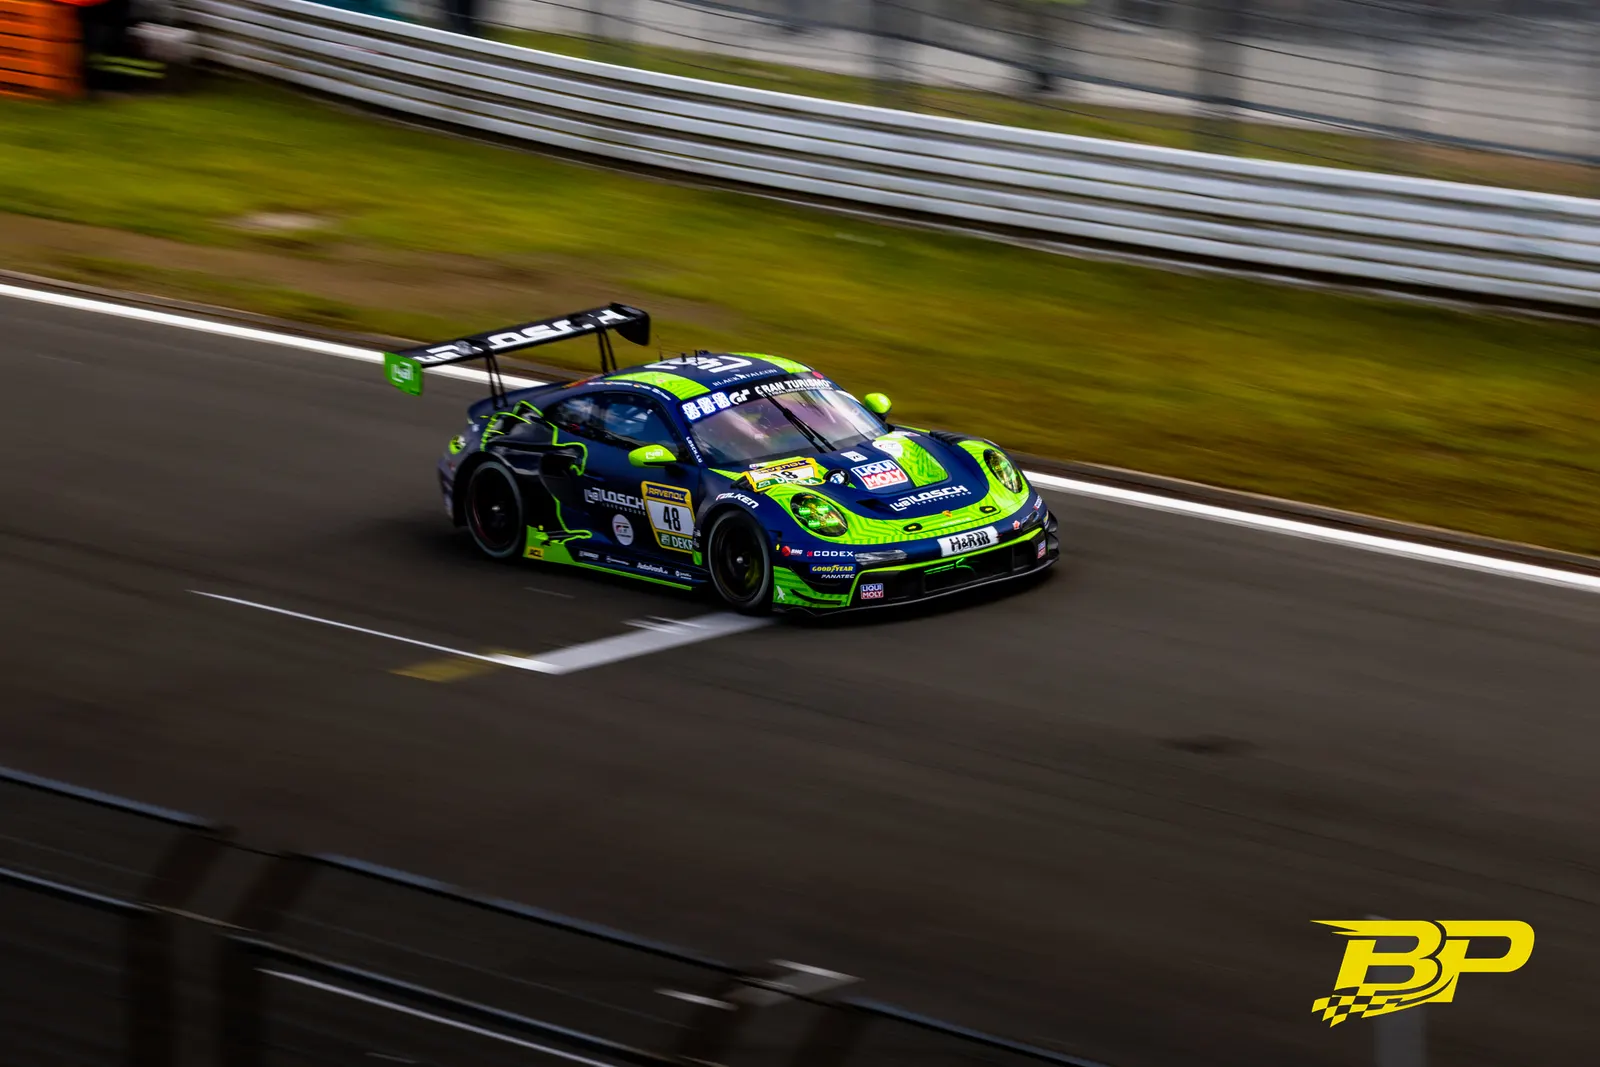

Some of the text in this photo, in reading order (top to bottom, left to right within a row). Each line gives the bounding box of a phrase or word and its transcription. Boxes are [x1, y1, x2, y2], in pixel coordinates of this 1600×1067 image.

[754, 381, 785, 396] GRAN
[784, 378, 831, 389] TURISMO
[855, 462, 896, 477] LIQUI
[863, 470, 904, 487] MOLY
[602, 489, 645, 510] LOSCH
[648, 487, 684, 500] RAVENOL
[716, 492, 759, 509] FALKEN
[910, 485, 969, 502] LOSCH
[663, 506, 681, 532] 48
[671, 536, 693, 550] DEKR
[949, 533, 978, 552] H&R
[812, 564, 853, 573] GOODYEAR
[862, 584, 882, 592] LIQUI
[862, 591, 883, 599] MOLY
